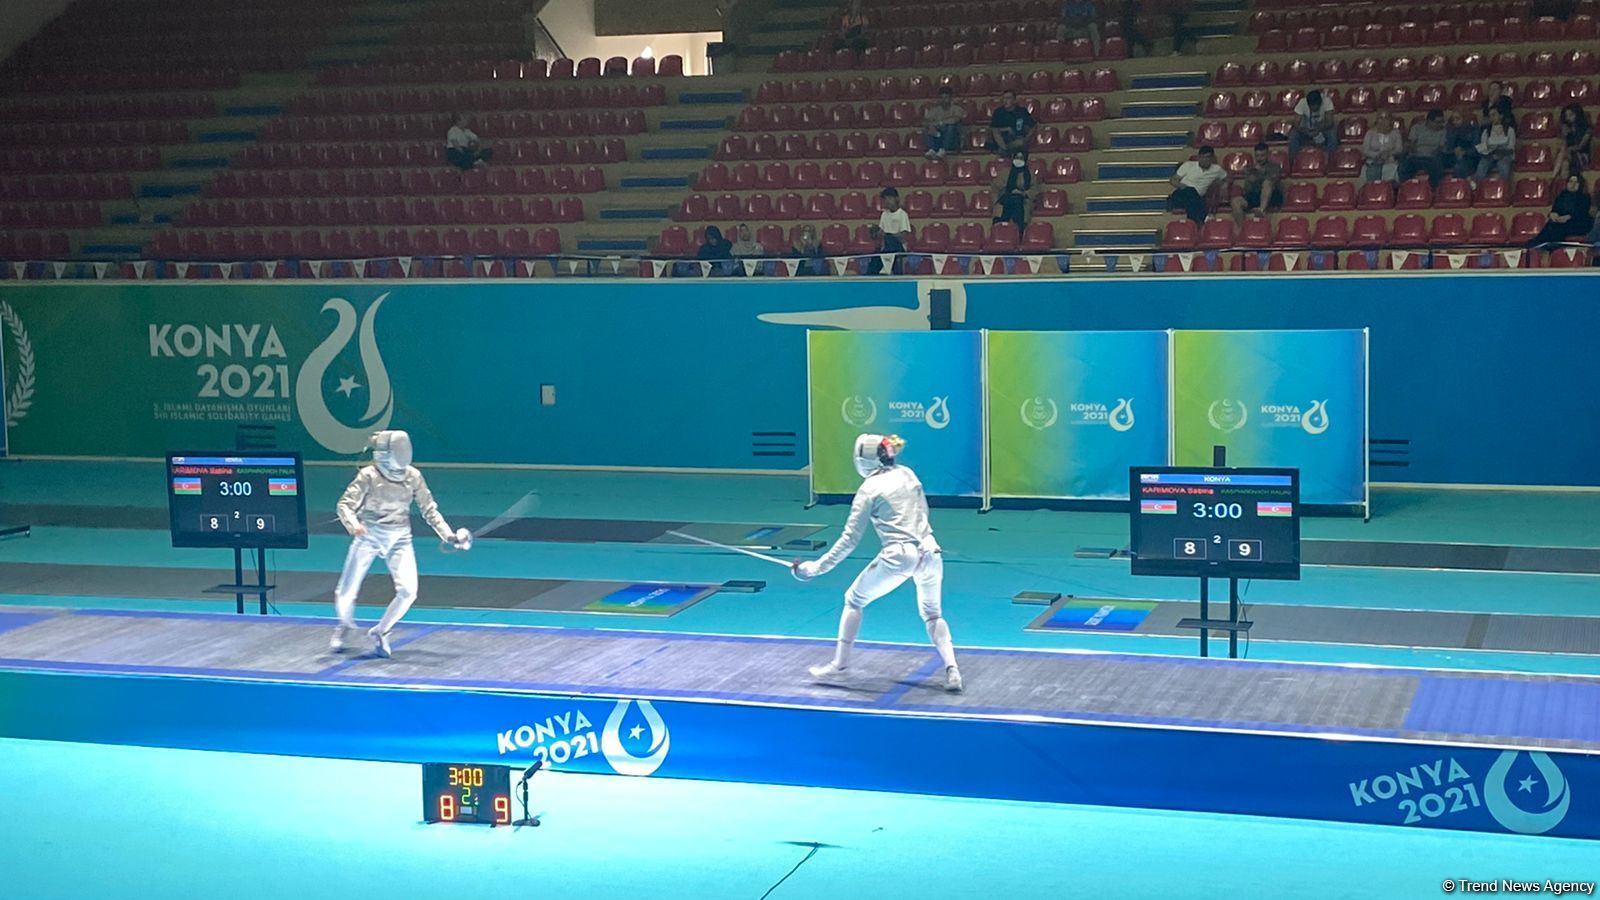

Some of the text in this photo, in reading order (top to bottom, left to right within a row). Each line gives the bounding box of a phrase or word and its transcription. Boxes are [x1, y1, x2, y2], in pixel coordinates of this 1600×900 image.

[149, 323, 287, 358] KONYA
[197, 364, 290, 399] 2021
[888, 401, 925, 411] KONYA
[1070, 403, 1108, 412] KONYA
[1261, 405, 1300, 414] KONYA
[901, 409, 925, 419] 2021
[1083, 411, 1108, 421] 2021
[1274, 413, 1301, 423] 2021
[1203, 475, 1232, 483] KONYA
[219, 481, 252, 496] 3:00
[234, 511, 241, 519] 2
[1192, 502, 1243, 519] 3:00
[210, 517, 219, 529] 8
[256, 518, 265, 529] 9
[1213, 535, 1221, 544] 2
[1184, 542, 1196, 555] 8
[1239, 543, 1251, 556] 9
[497, 710, 592, 755] KONYA
[533, 732, 599, 769] 2021
[449, 767, 483, 787] 3:00
[1349, 757, 1471, 807] KONYA
[462, 787, 471, 805] 2
[440, 795, 454, 820] 8
[494, 797, 508, 823] 9
[1398, 782, 1480, 825] 2021
